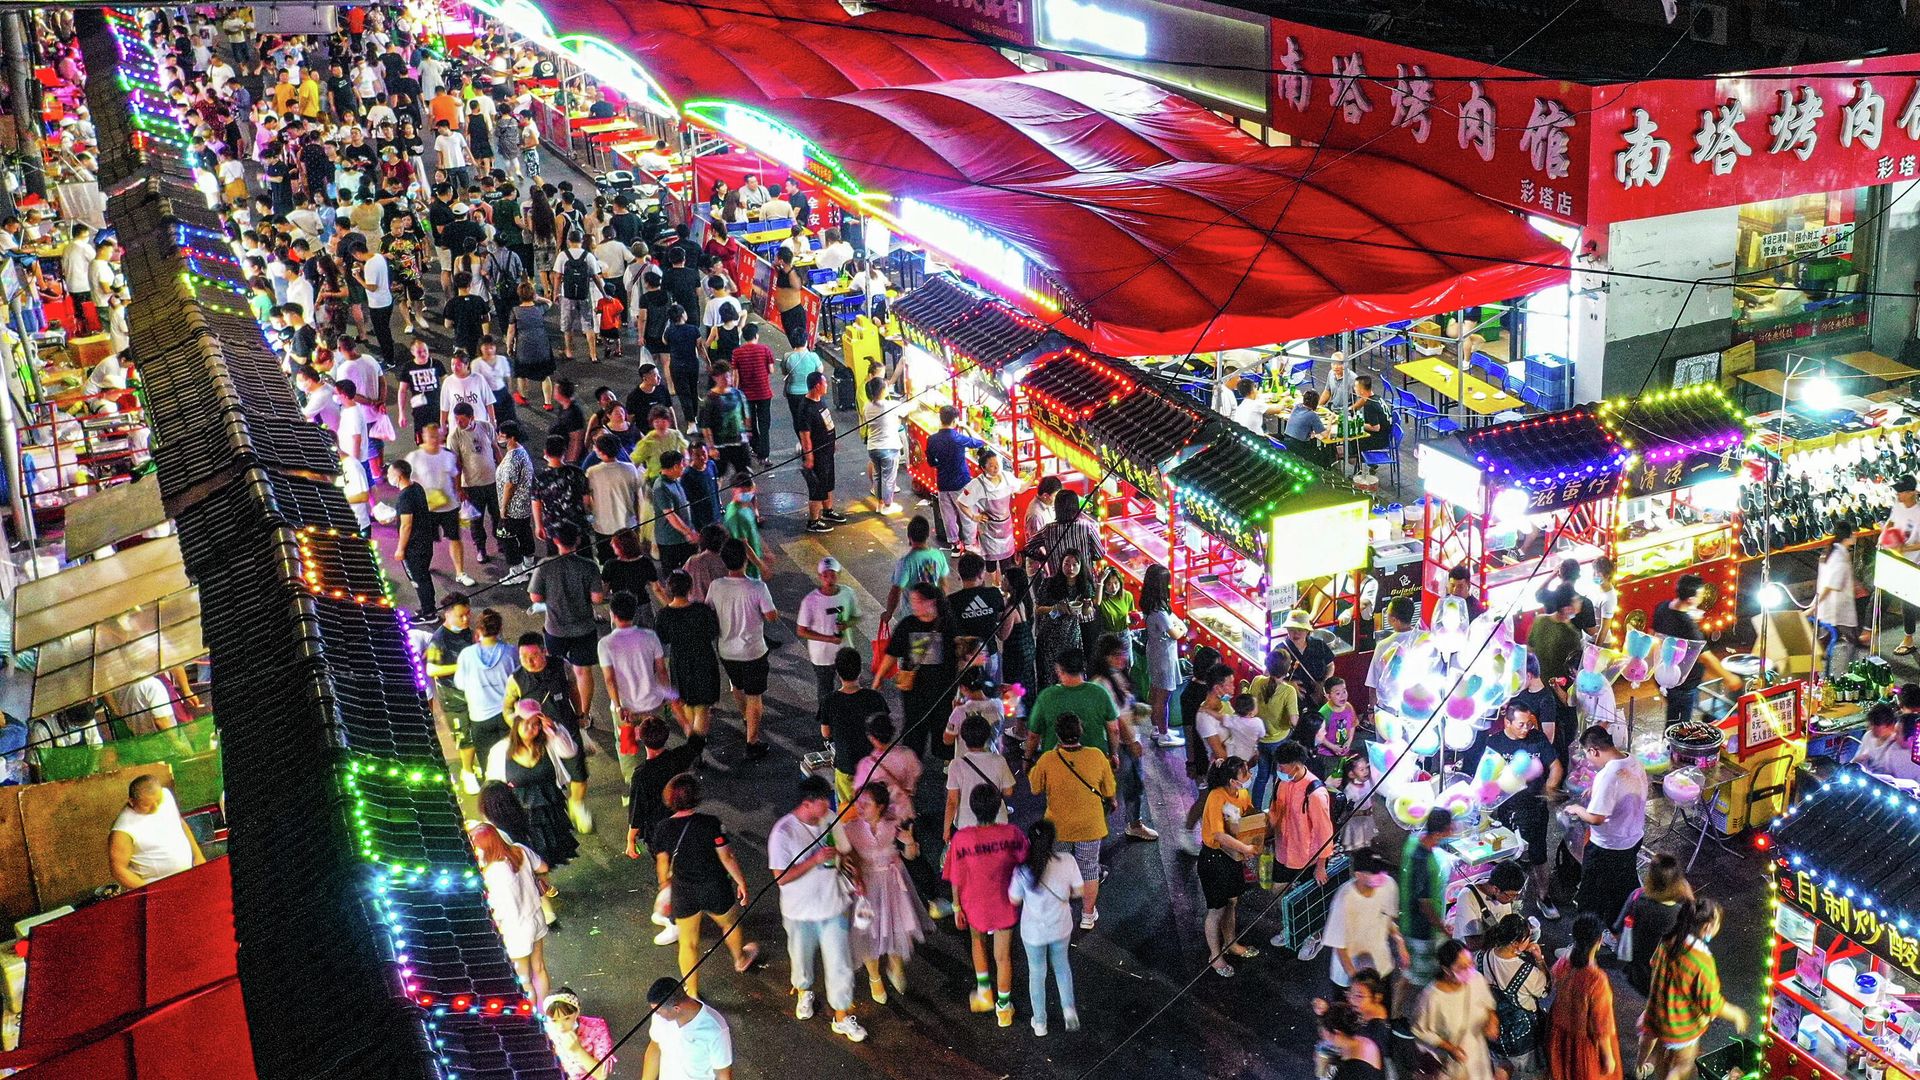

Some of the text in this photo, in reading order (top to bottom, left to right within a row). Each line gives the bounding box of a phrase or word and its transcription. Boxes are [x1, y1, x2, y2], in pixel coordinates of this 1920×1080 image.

[1278, 36, 1577, 180] 南塔烤肉馆
[1520, 179, 1573, 216] 彩塔店
[1764, 245, 1784, 257] 营业中
[1639, 441, 1733, 492] 清凉一夏
[961, 607, 994, 619] adidas
